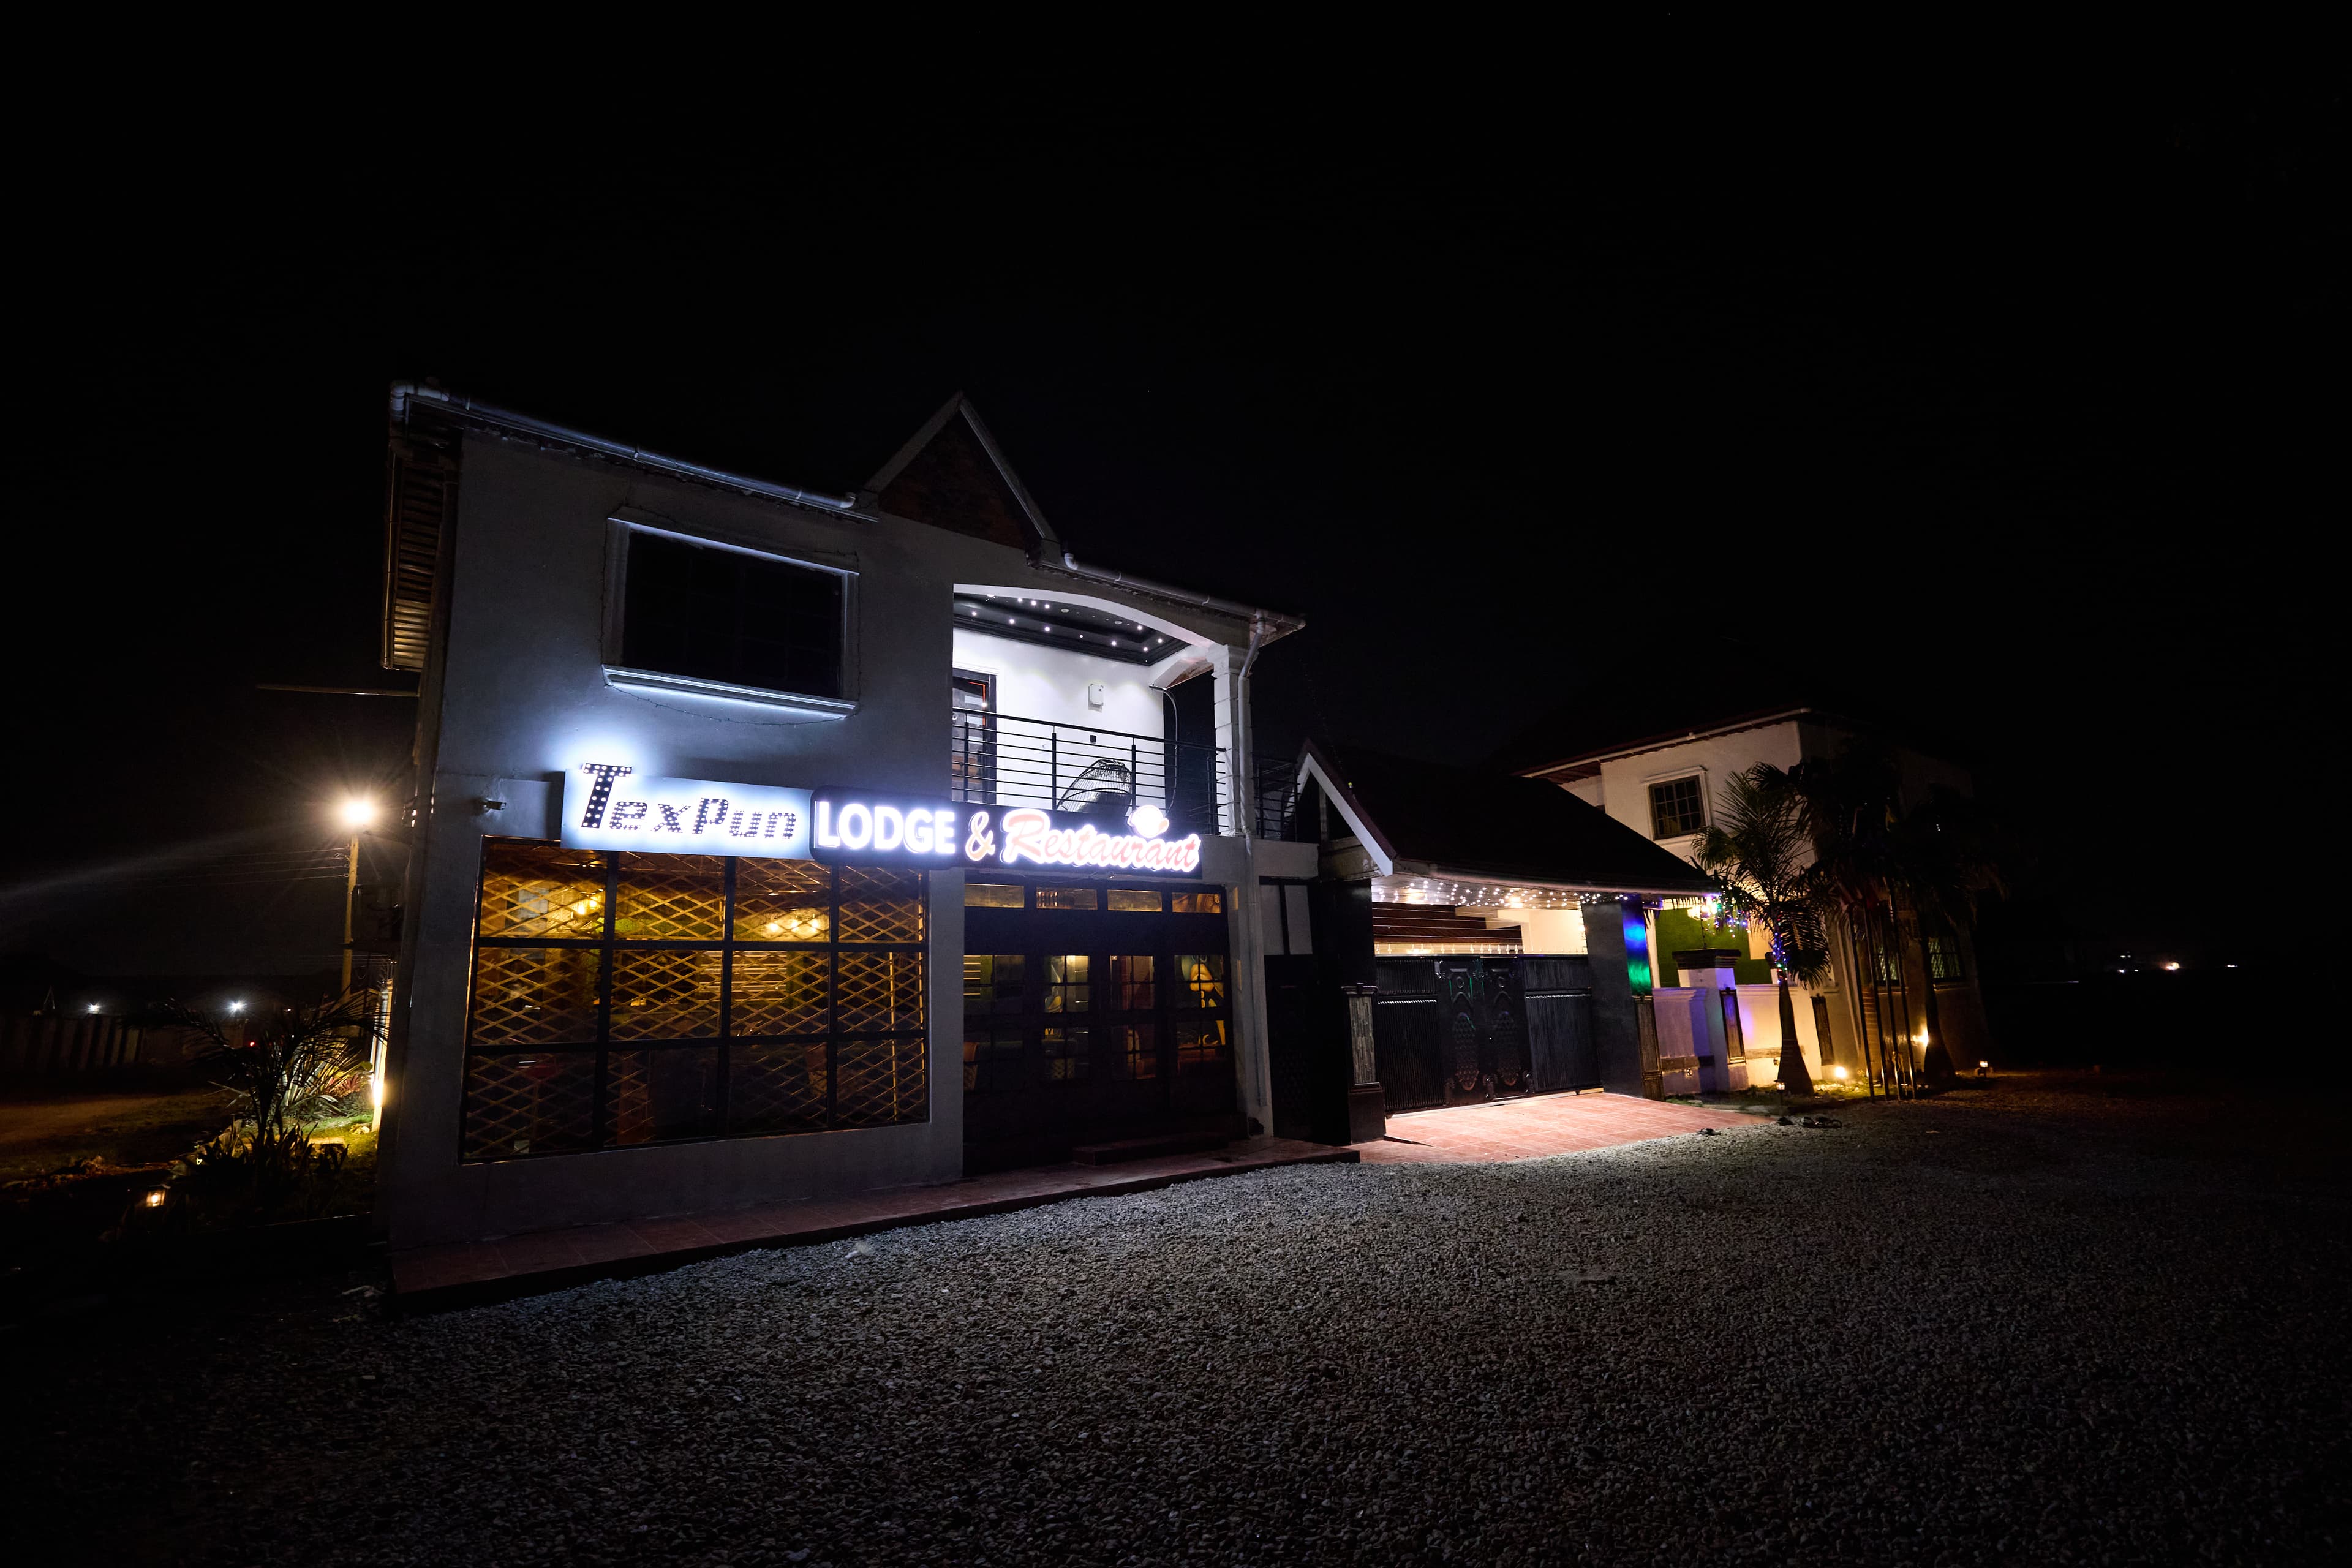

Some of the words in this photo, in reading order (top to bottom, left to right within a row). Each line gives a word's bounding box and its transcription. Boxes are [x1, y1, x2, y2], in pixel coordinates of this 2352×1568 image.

[580, 762, 797, 840] TexPun
[814, 800, 956, 854] LODGE
[965, 810, 996, 862] &
[1000, 808, 1202, 873] Restaurant
